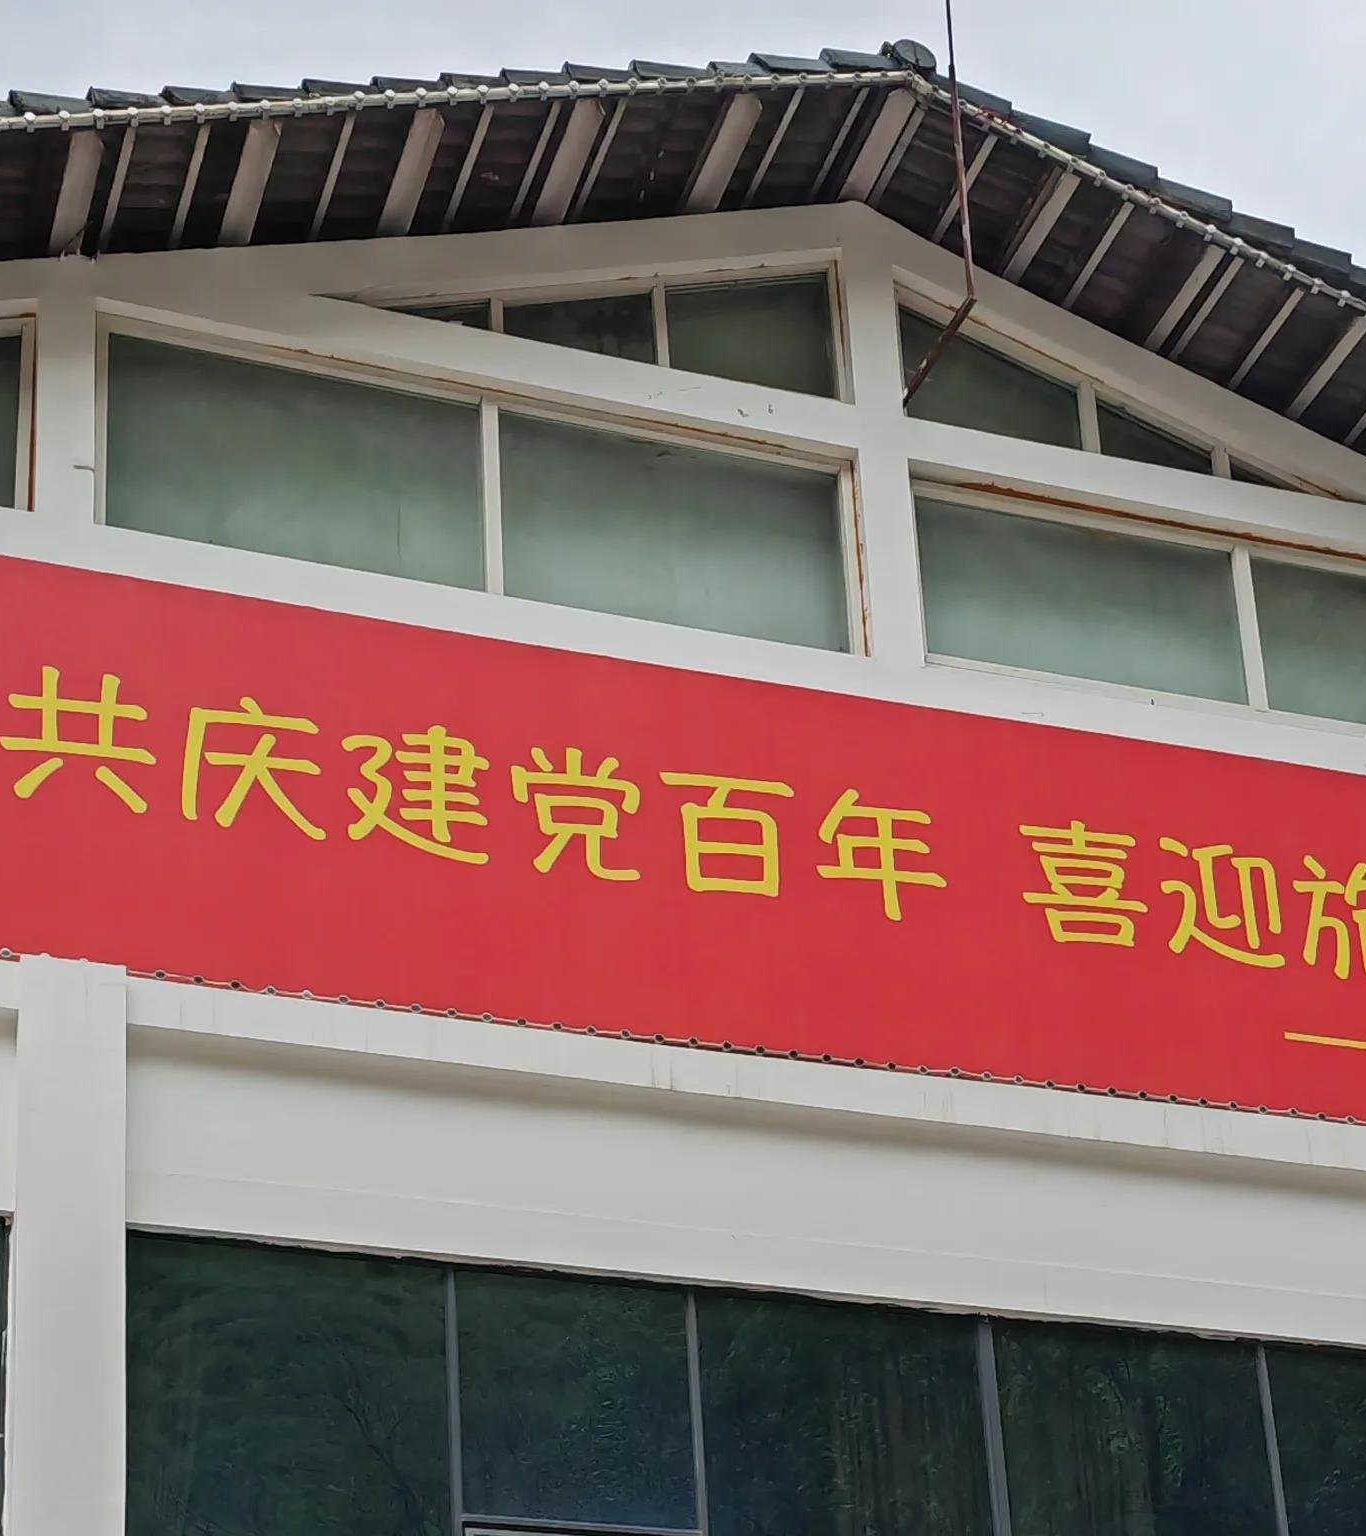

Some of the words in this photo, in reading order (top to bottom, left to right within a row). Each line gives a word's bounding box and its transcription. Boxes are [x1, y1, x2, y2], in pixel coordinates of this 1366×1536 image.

[0, 666, 947, 920] 共庆建党百年
